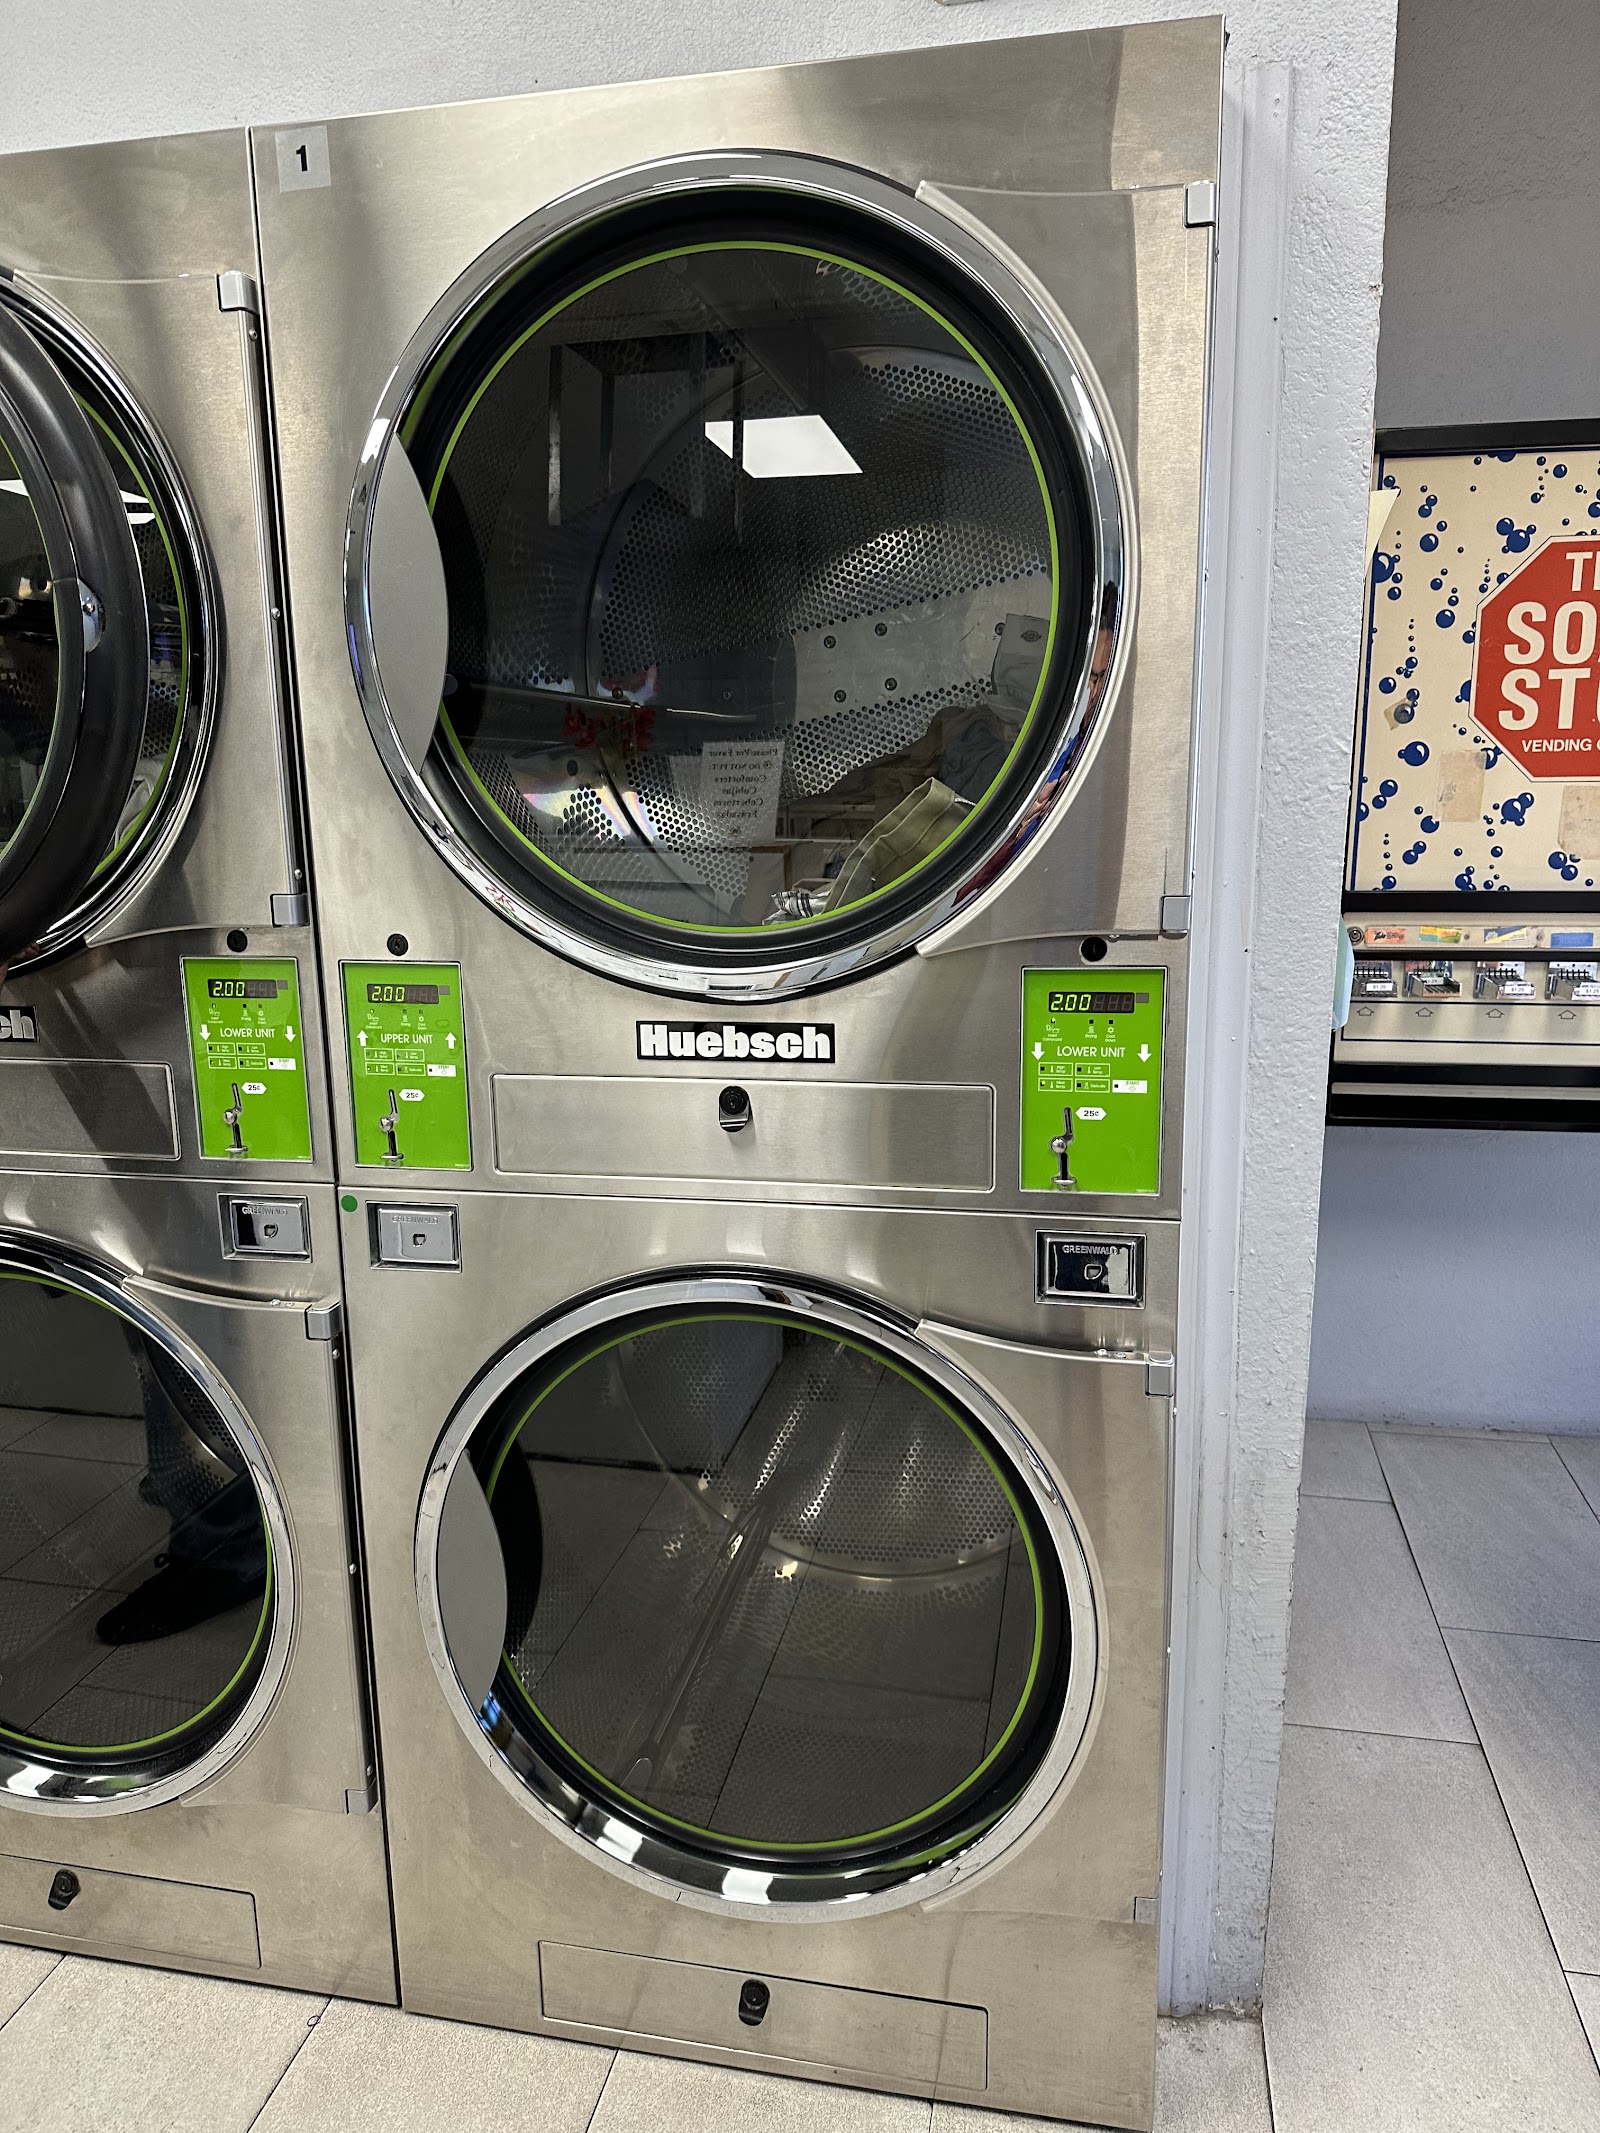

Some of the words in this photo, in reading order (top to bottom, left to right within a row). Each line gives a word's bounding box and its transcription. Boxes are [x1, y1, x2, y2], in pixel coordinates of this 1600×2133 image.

[295, 144, 308, 172] 1
[1565, 551, 1600, 592] T
[1503, 601, 1600, 665] SO
[1498, 667, 1600, 731] ST
[1521, 739, 1592, 752] VENDING
[213, 981, 246, 997] 2.00
[371, 986, 405, 1002] 2.00
[1050, 993, 1092, 1011] 2.00
[219, 1027, 252, 1038] LOWER
[255, 1028, 275, 1038] UNIT
[380, 1033, 410, 1044] UPPER
[412, 1034, 433, 1044] UNIT
[639, 1024, 831, 1059] Huebsch
[1056, 1045, 1097, 1057] LOWER
[1100, 1046, 1125, 1058] UNIT
[1061, 1244, 1118, 1255] GREENWALD
